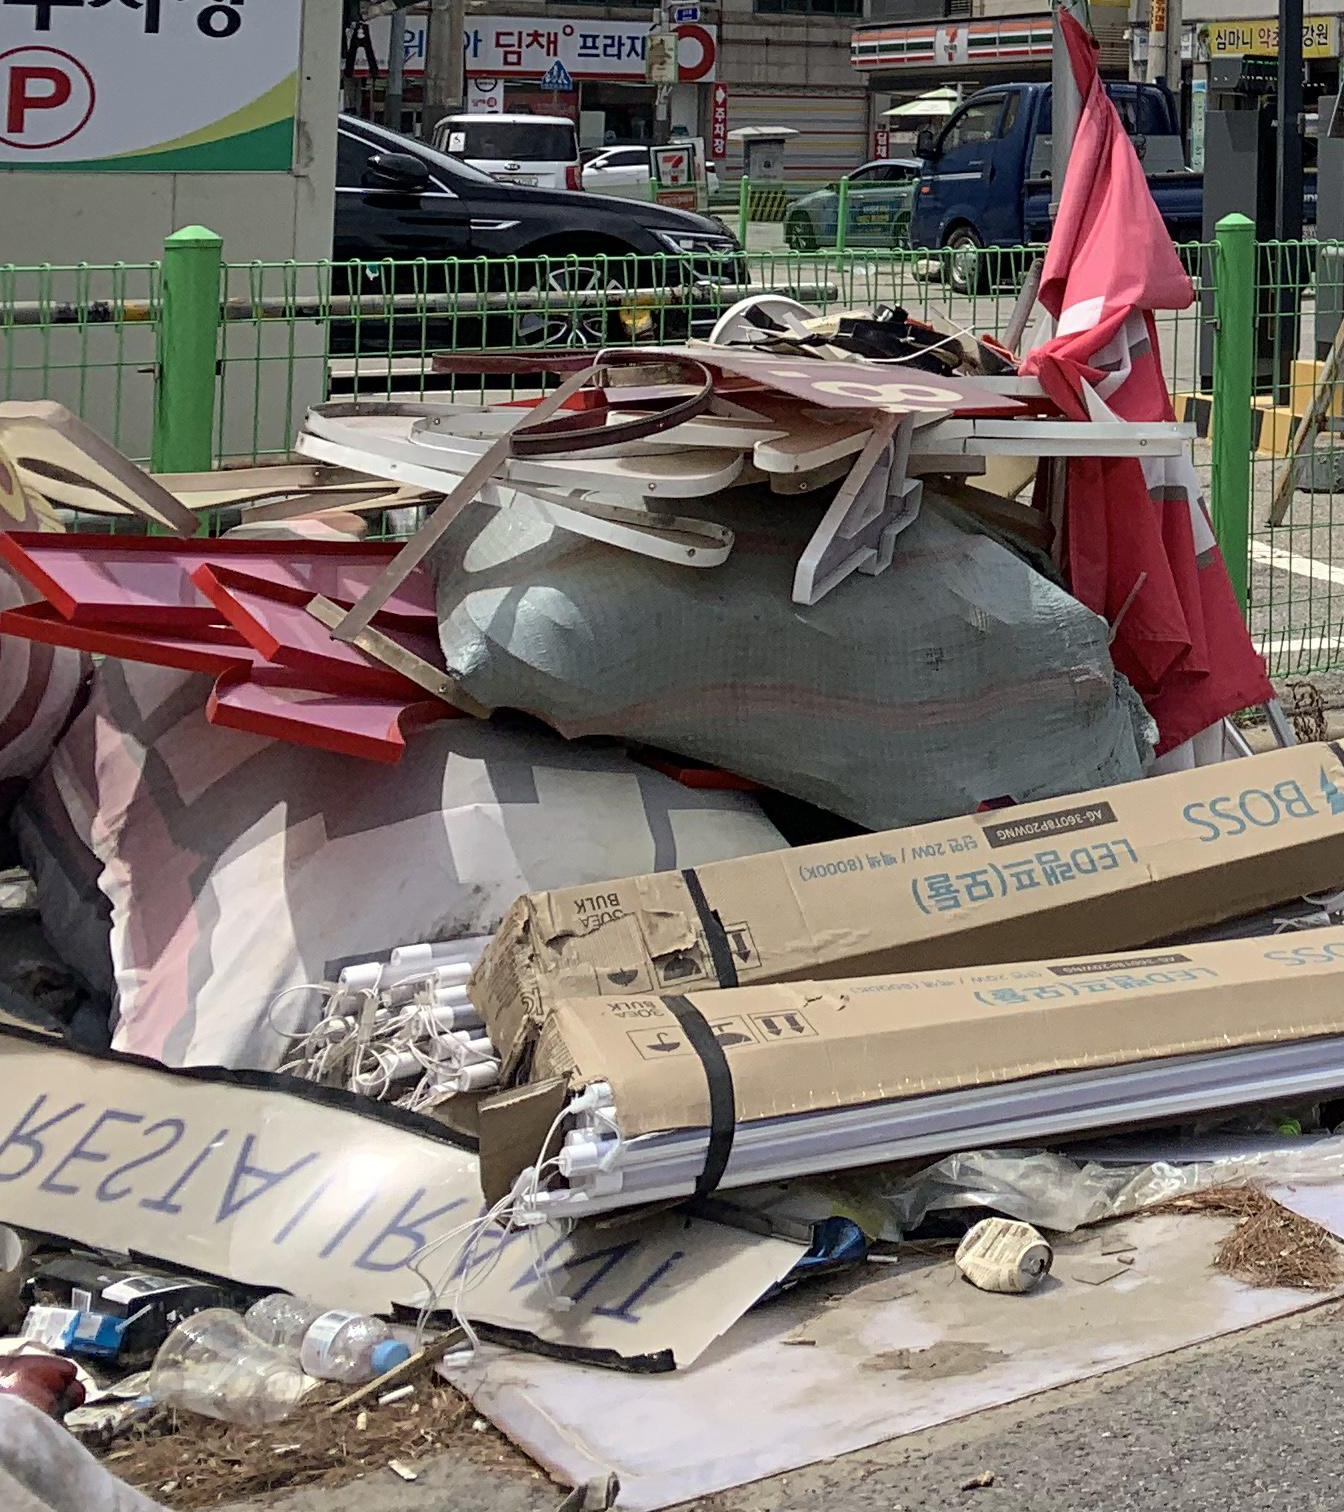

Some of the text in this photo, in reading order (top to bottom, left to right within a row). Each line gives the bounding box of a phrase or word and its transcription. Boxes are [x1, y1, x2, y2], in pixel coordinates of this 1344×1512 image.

[494, 29, 559, 67] 딤채
[1215, 26, 1253, 51] 심마니
[7, 66, 72, 134] P
[713, 107, 726, 155] 주차장
[1183, 777, 1318, 842] BOSS
[911, 841, 944, 861] 20W
[911, 838, 1138, 916] LED램프(모듈)
[573, 892, 620, 915] BULK
